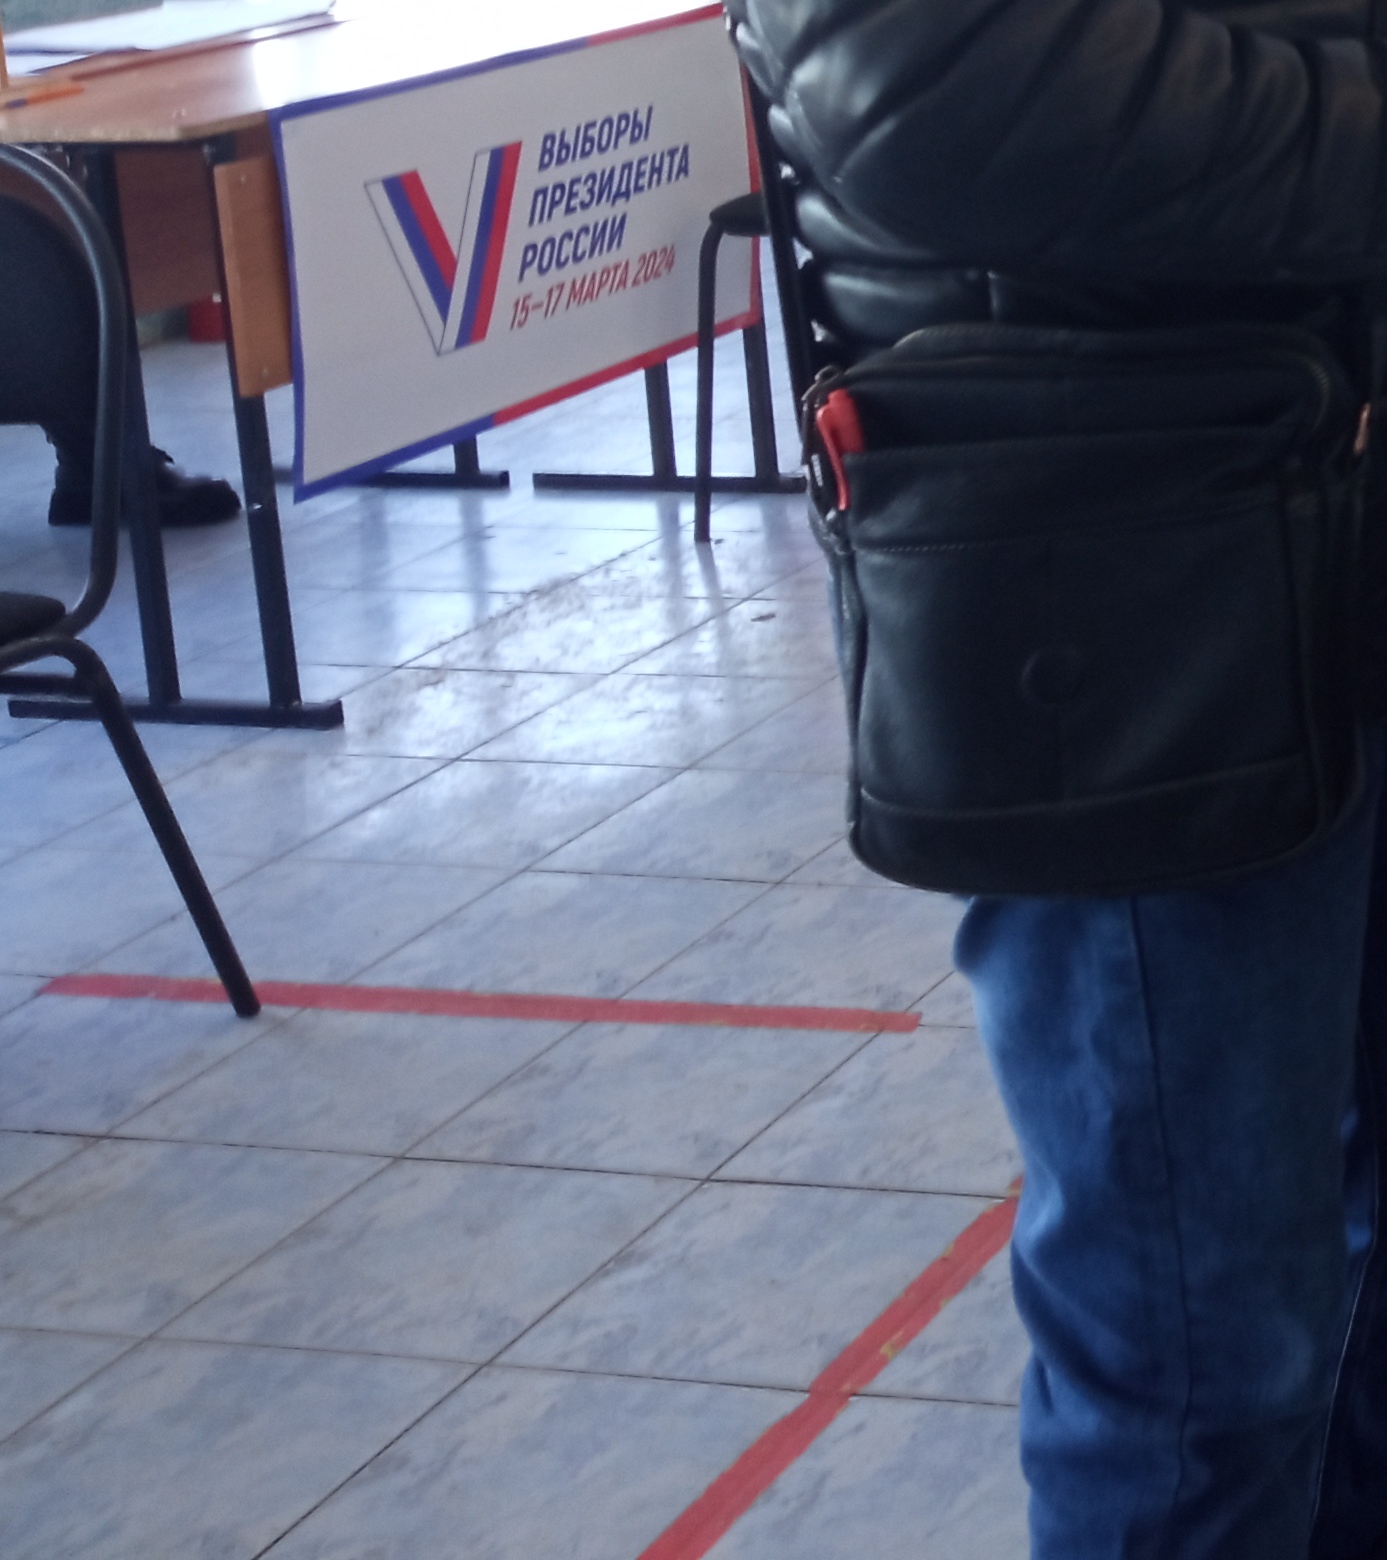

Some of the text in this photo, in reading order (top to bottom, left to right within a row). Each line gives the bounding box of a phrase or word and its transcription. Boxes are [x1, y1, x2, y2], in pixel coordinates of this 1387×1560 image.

[538, 103, 654, 172] ВЫБОРЫ
[528, 143, 690, 228] ПРЕЗИДЕНТА
[518, 212, 628, 283] РОССИИ
[566, 259, 631, 311] МАРТА
[631, 243, 677, 288] 2024
